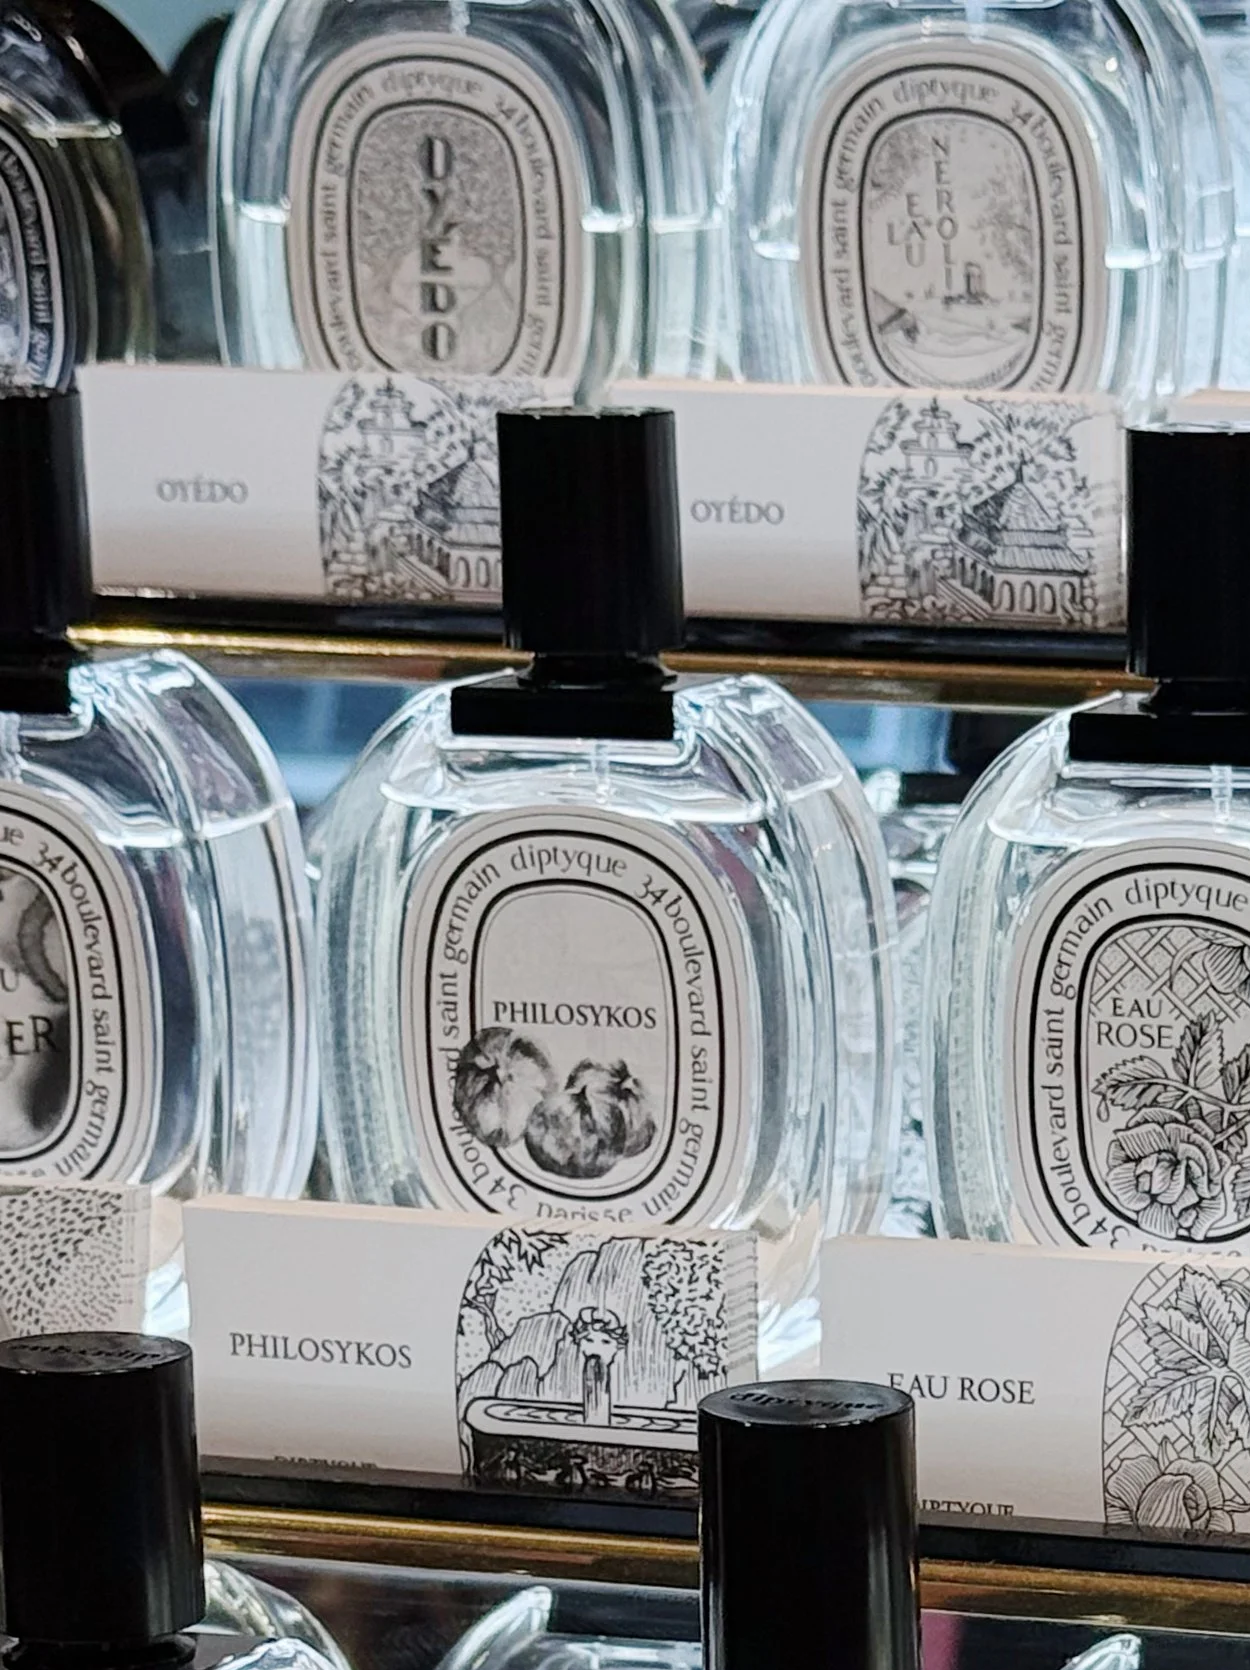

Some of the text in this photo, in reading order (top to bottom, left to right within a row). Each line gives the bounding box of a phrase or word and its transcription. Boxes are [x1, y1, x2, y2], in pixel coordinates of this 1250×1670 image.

[892, 77, 1002, 110] diptyque
[320, 251, 362, 371] oulevard
[690, 493, 786, 527] OYÉDO
[510, 844, 629, 879] diptyque
[632, 873, 666, 910] 34
[1124, 877, 1250, 914] diptyque
[60, 861, 113, 1001] boulevard
[443, 861, 501, 966] germain
[663, 892, 712, 1039] boulevard
[1048, 894, 1115, 1003] germain
[437, 971, 461, 1041] saint
[491, 1000, 658, 1030] PHILOSYKOS
[1097, 1022, 1175, 1051] ROSE
[1112, 996, 1163, 1020] EAU
[92, 1007, 117, 1074] saint
[1039, 1006, 1066, 1077] saint
[690, 1043, 712, 1114] saint
[53, 1077, 111, 1179] germain
[1039, 1083, 1093, 1230] boulevard
[641, 1117, 706, 1219] germain
[228, 1331, 413, 1372] PHILOSYKOS
[957, 1375, 1036, 1405] ROSE
